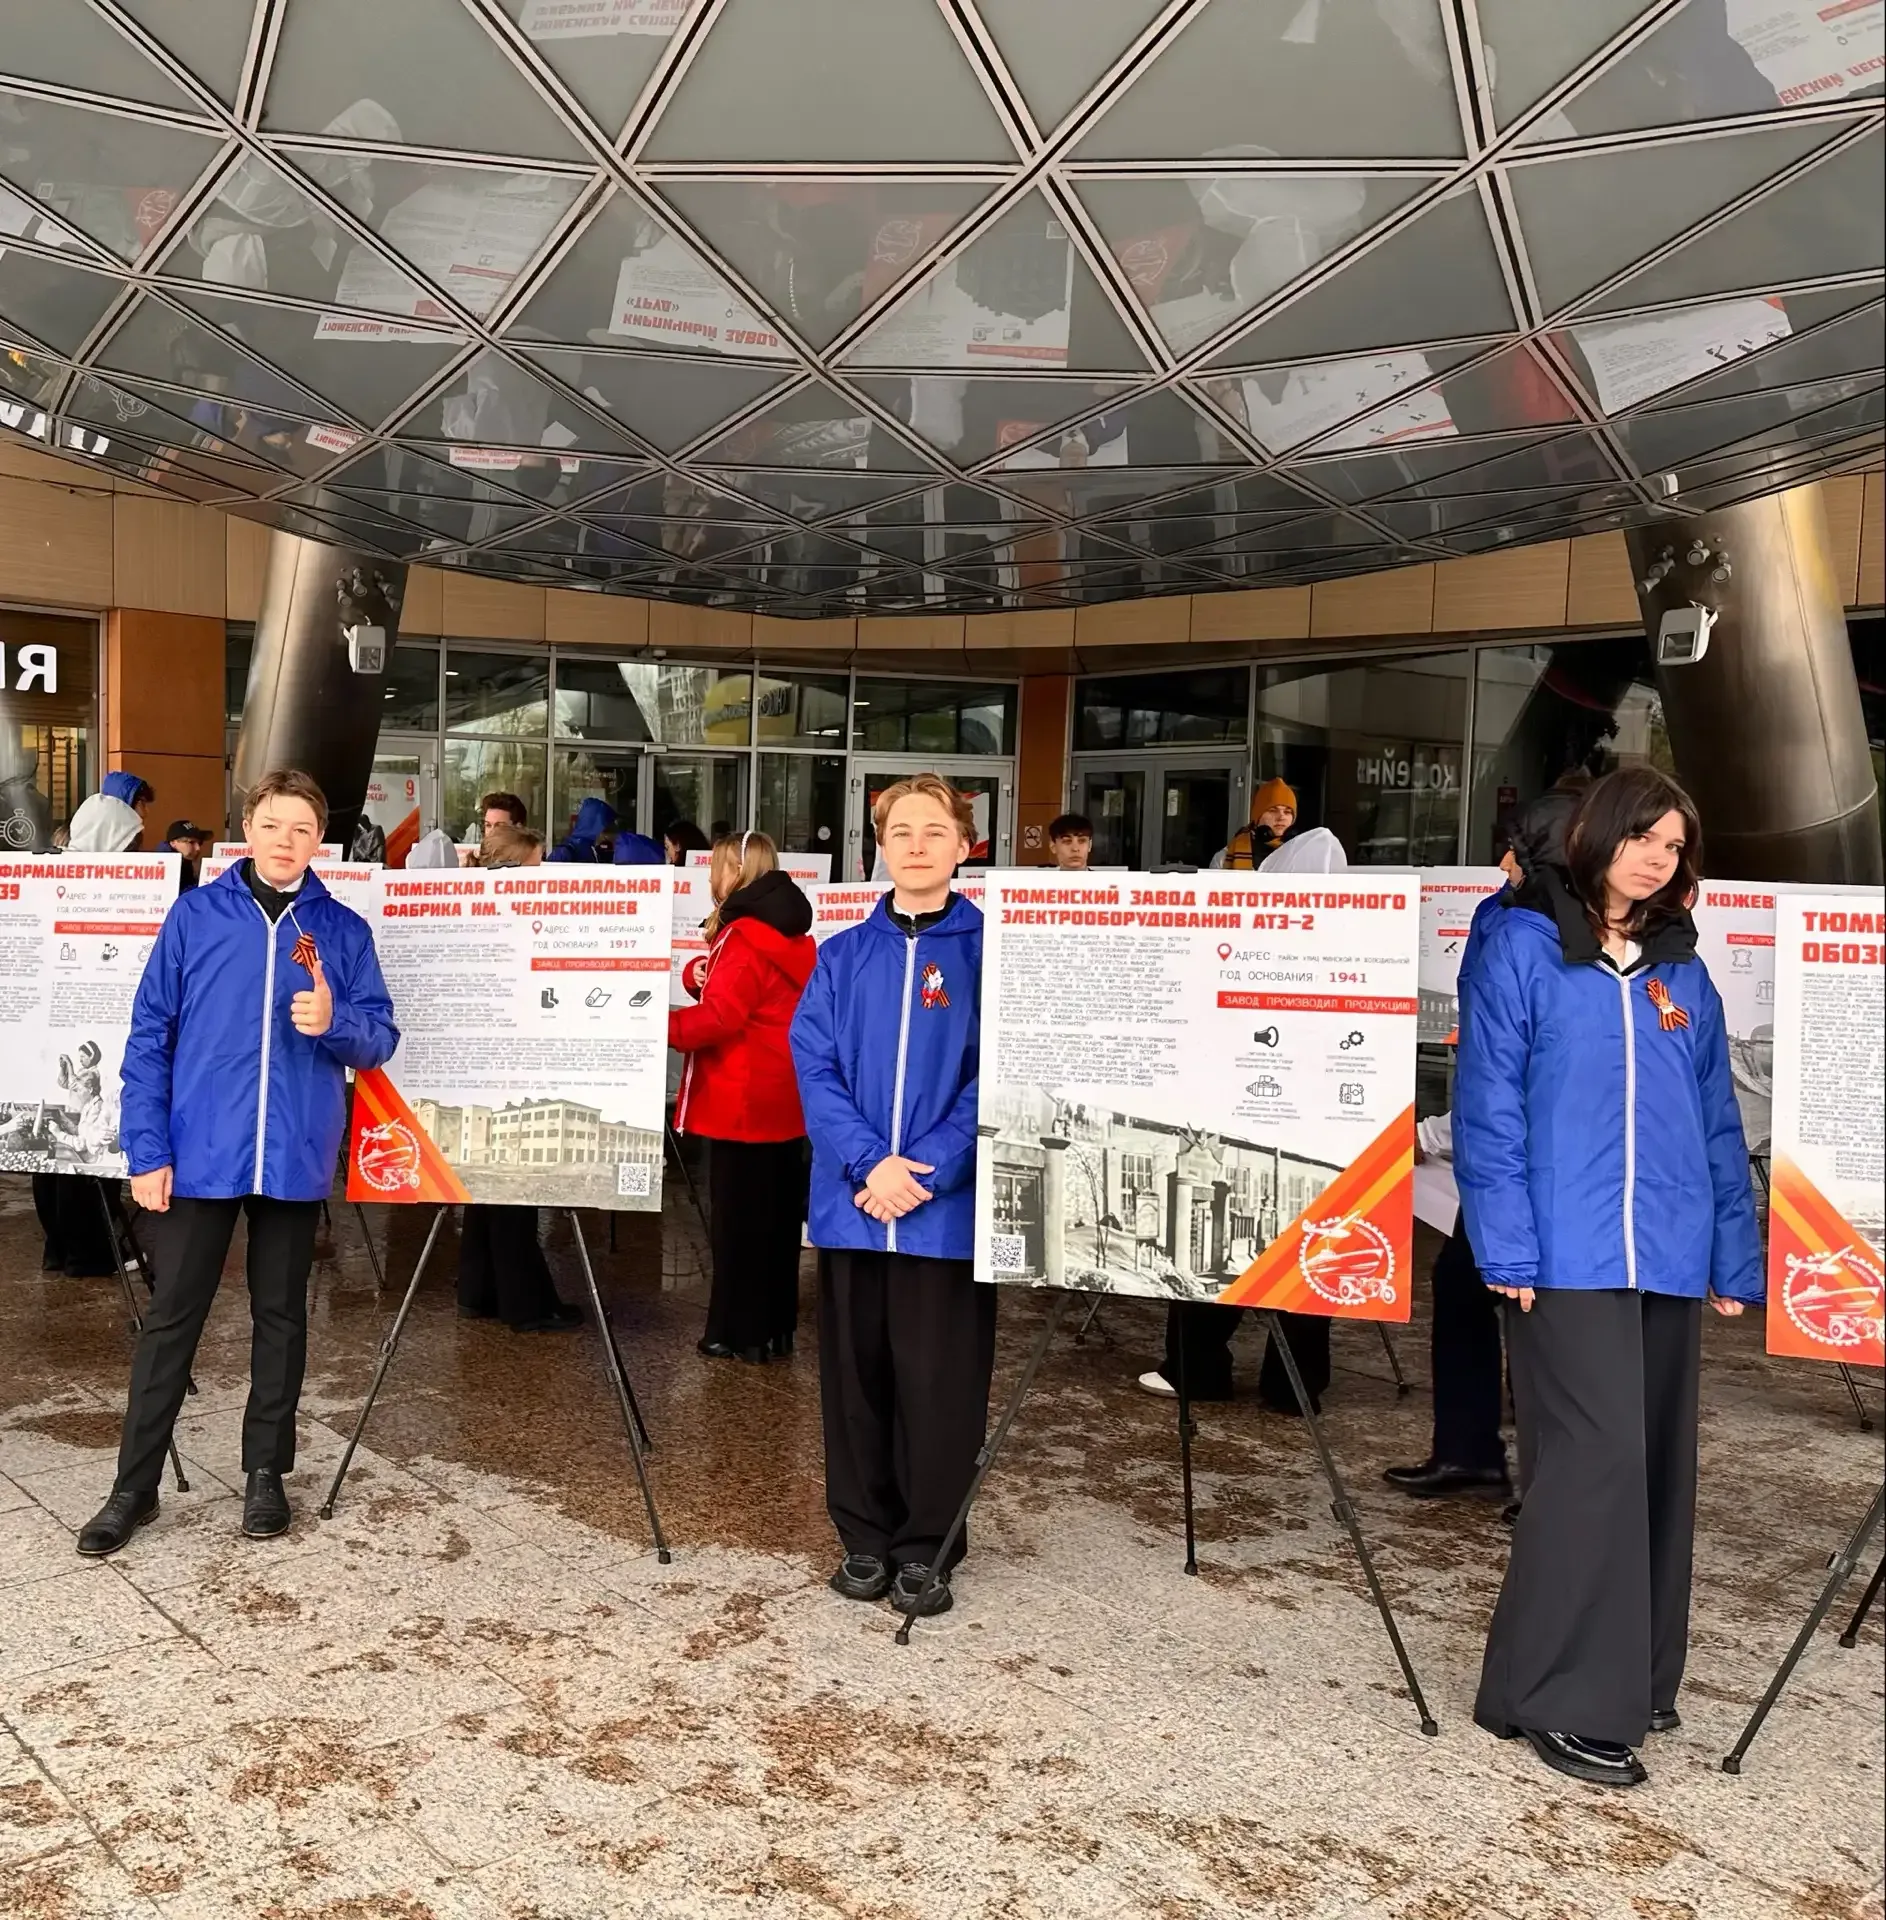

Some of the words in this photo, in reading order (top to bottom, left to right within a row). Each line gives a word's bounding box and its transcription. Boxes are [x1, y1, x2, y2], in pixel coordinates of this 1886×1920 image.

[0, 641, 57, 693] Я
[405, 779, 415, 796] 9
[0, 861, 165, 880] ФАРМАЦЕВТИЧЕСКИЙ
[314, 868, 374, 882] ЛЯТОРНЫЙ
[384, 881, 485, 897] ТЮМЕНСКАЯ
[494, 878, 662, 895] САПОГОВАЛЯЛЬНАЯ
[1421, 885, 1500, 894] НКОСТРОИТЕЛЬ
[816, 890, 884, 905] ТЮМЕНС
[1000, 885, 1119, 905] ТЮМЕНСКИЙ
[1129, 890, 1196, 907] ЗАВОД
[1207, 892, 1407, 910] АВТОТРАКТОРНОГО
[1706, 892, 1776, 909] КОЖЕВ
[382, 901, 462, 917] ФАБРИКА
[471, 901, 502, 916] ИМ.
[511, 899, 637, 916] ЧЕЛЮСКИНЦЕВ
[817, 908, 865, 922] ЗАВОД
[1001, 909, 1241, 929] ЭЛЕКТРООБОРУДОВАНИЯ
[1252, 913, 1314, 931] АТЭ-2
[609, 939, 637, 949] 1917
[1234, 951, 1271, 963] АДРЕС
[1219, 970, 1241, 981] ГОД
[1328, 971, 1368, 984] 1941
[1224, 995, 1260, 1008] ЗАВОД
[1266, 996, 1338, 1010] ПРОИЗВОДИЛ
